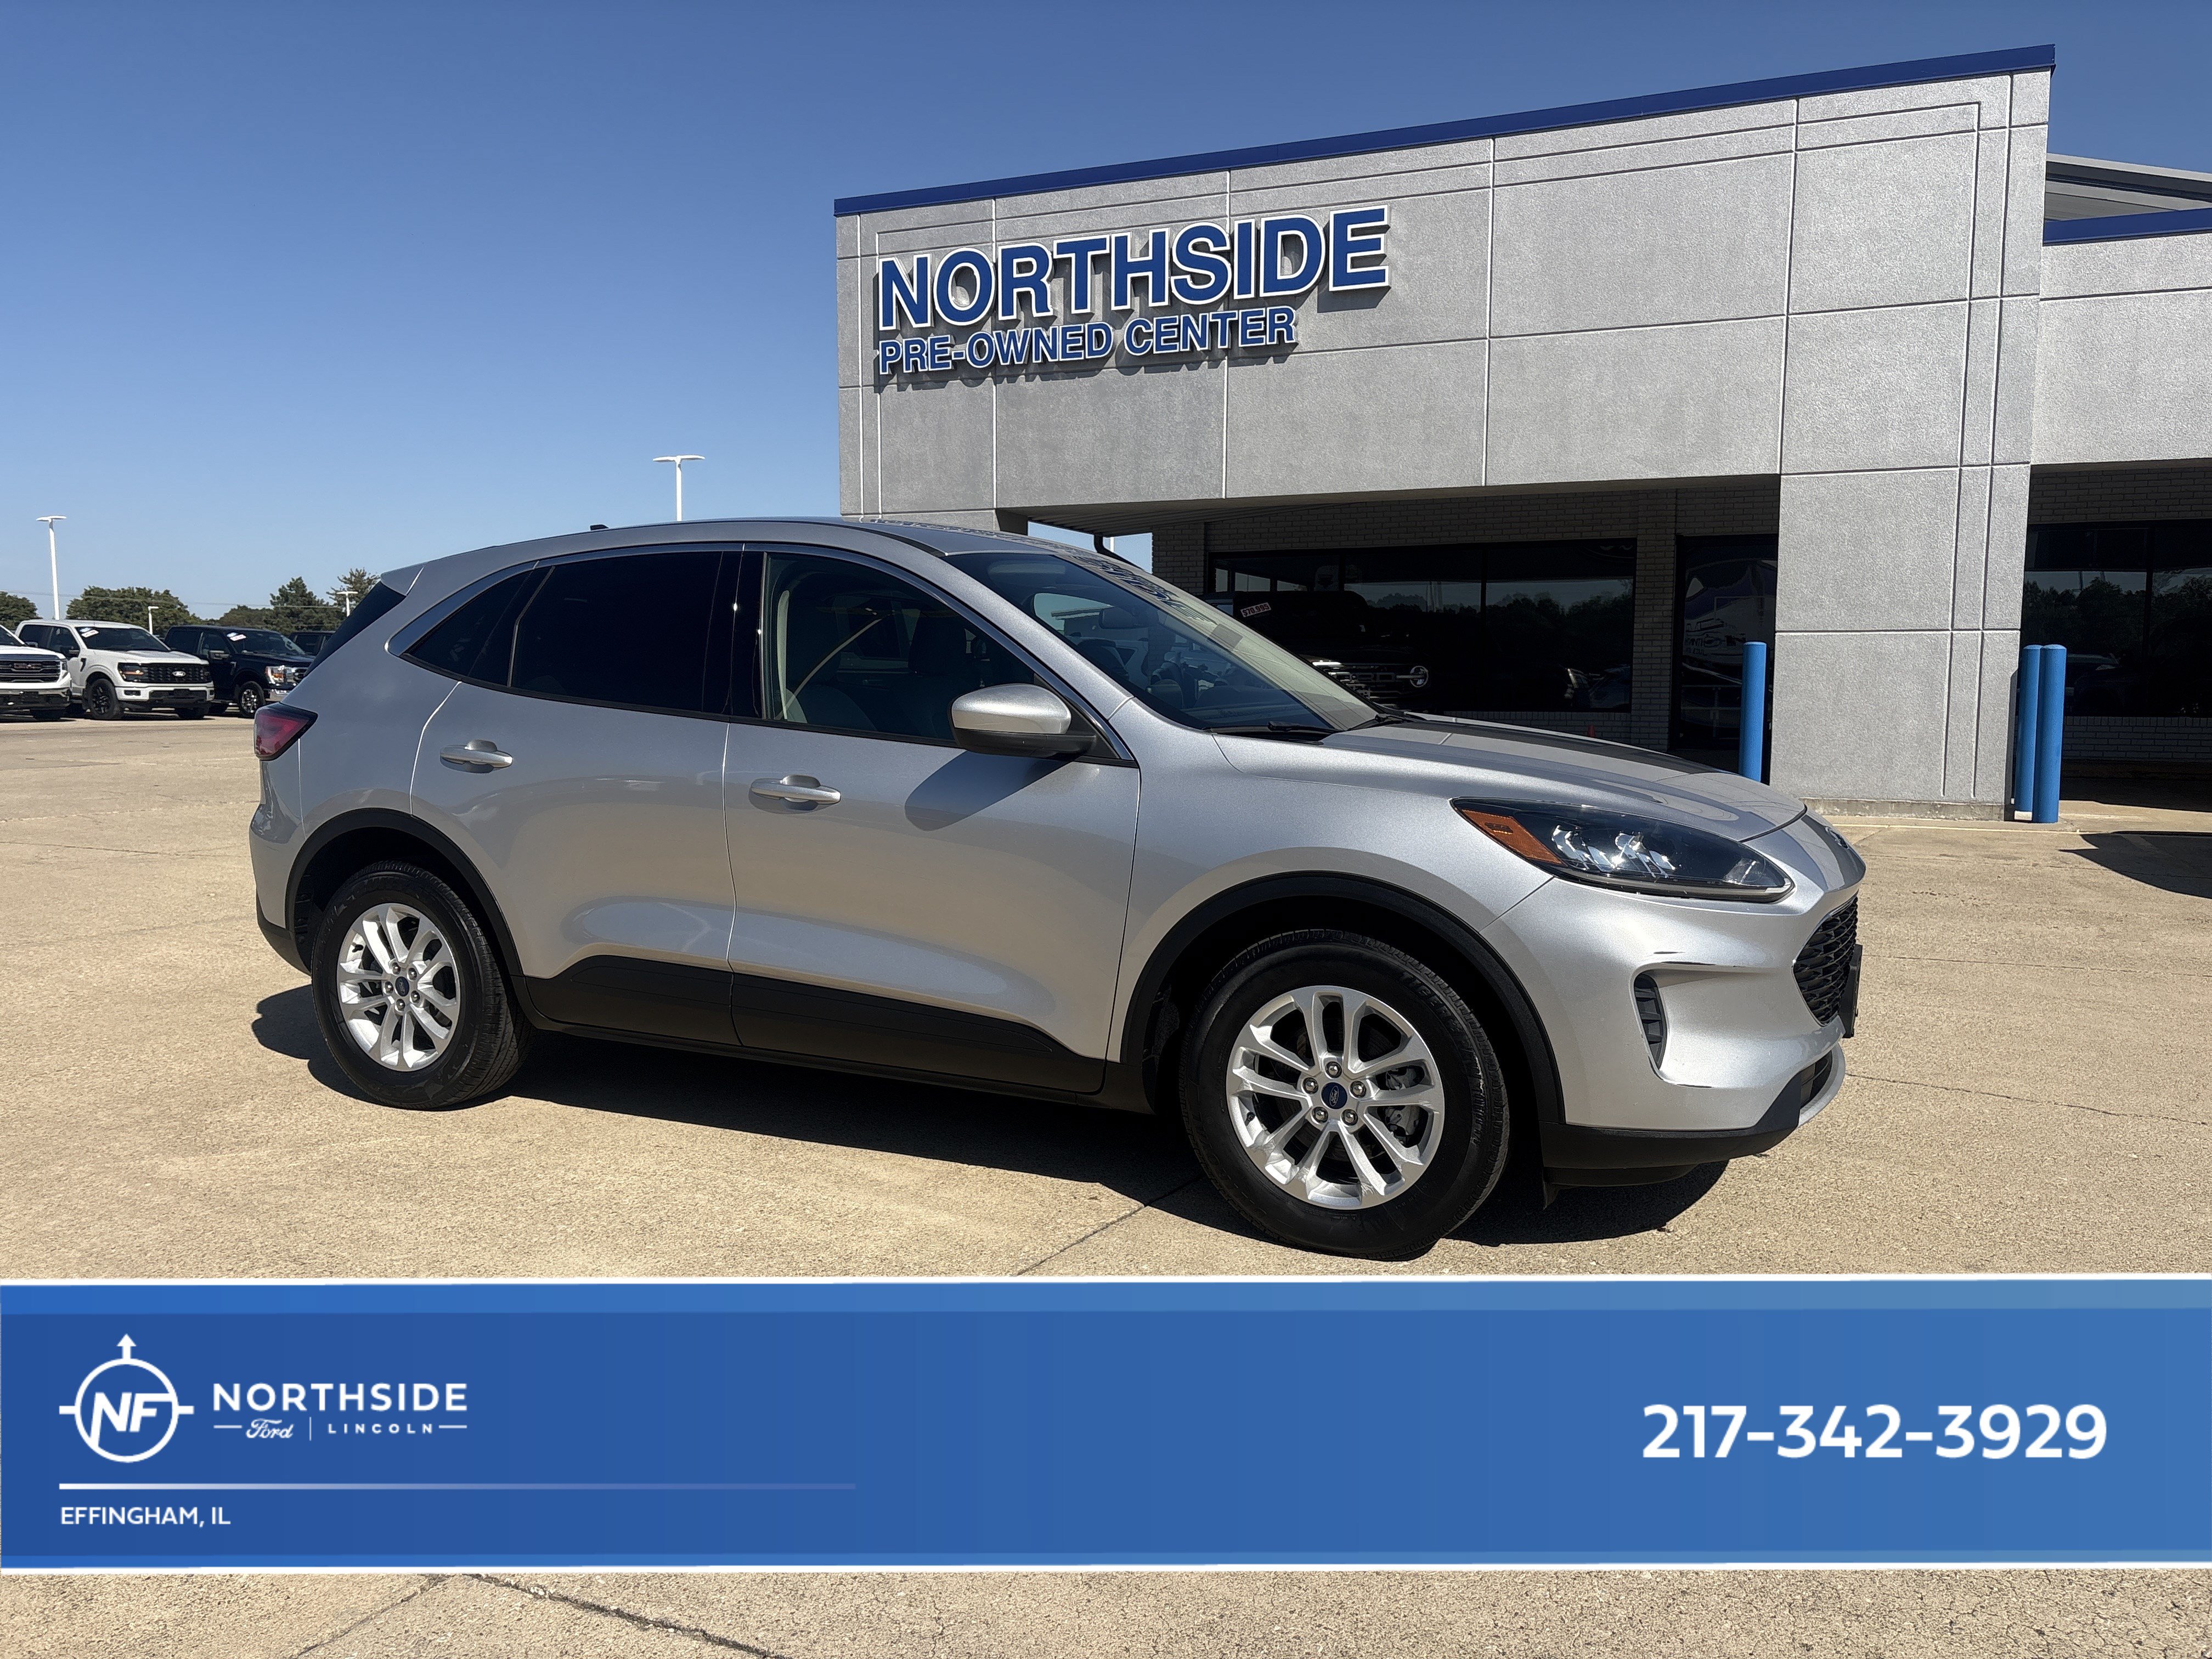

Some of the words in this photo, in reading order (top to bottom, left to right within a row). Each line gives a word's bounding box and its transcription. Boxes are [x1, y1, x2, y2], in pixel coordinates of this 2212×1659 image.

[879, 205, 1390, 331] NORTHSIDE
[879, 321, 1113, 375] PRE-OWNED
[1124, 306, 1296, 356] CENTER
